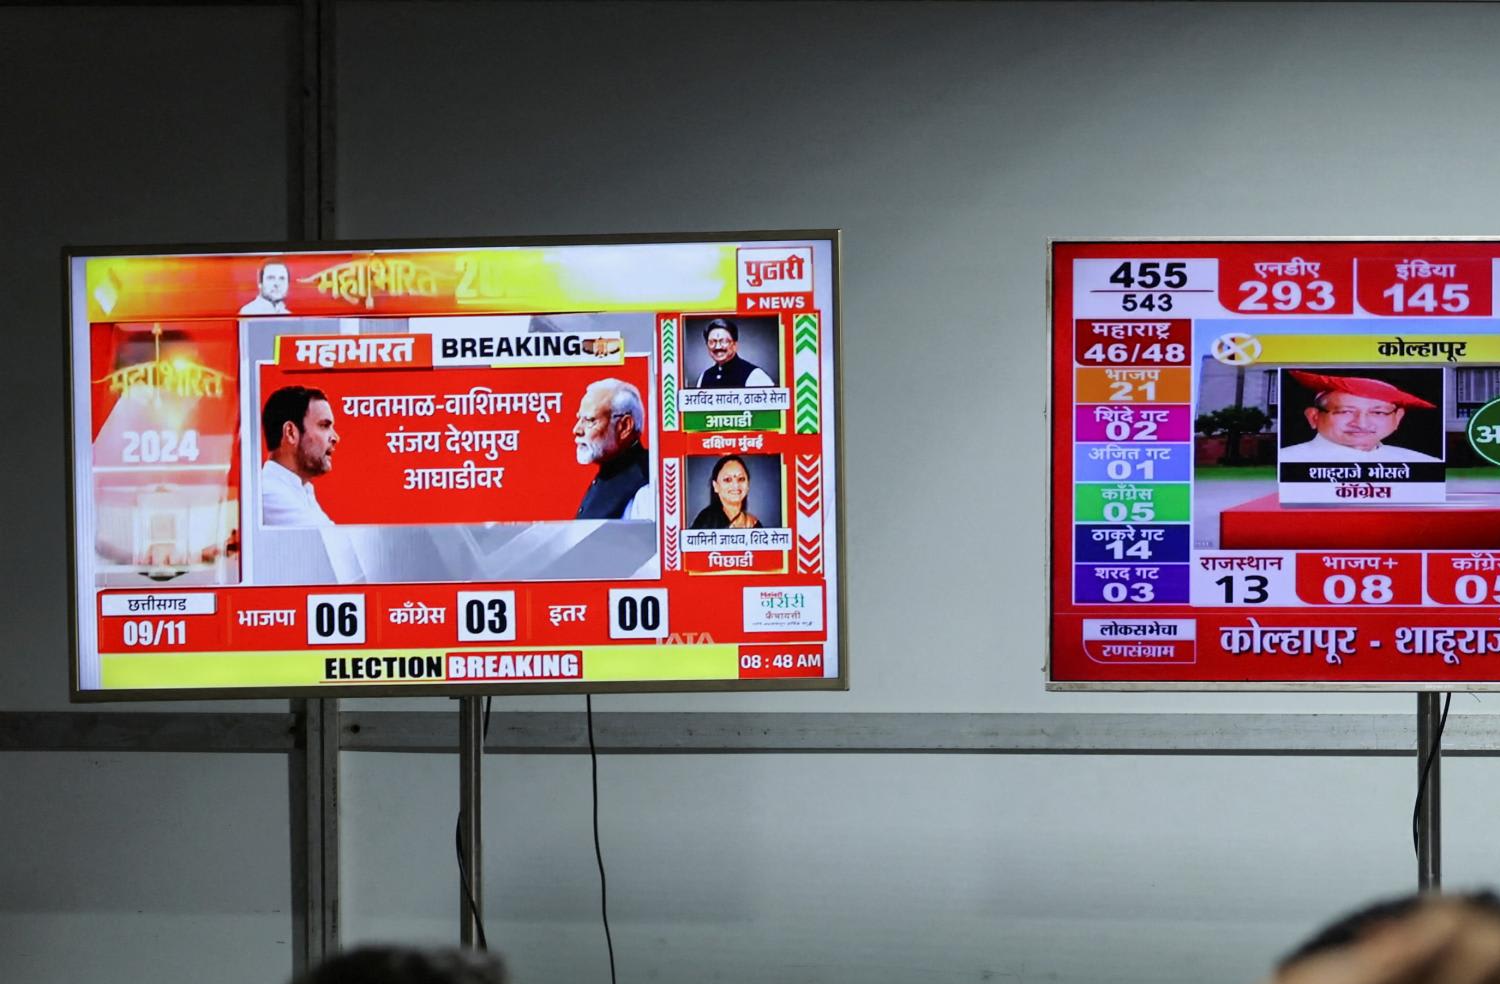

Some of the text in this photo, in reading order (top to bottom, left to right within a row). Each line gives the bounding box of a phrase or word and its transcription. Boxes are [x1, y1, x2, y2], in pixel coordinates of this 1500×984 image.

[745, 254, 804, 286] पुढारी
[1109, 262, 1187, 288] 455
[1254, 257, 1456, 280] एनडीए इंडिया
[760, 296, 805, 309] NEWS
[1122, 294, 1173, 312] 543
[1238, 280, 1470, 313] 293 145
[1091, 322, 1171, 339] महाराष्ट्र
[296, 335, 581, 367] महाभारत BREAKING
[1084, 343, 1185, 362] 46/48
[1377, 337, 1467, 362] कोल्हापूर
[1106, 369, 1160, 381] भाजप
[744, 391, 767, 404] ठाकरे
[769, 390, 787, 404] सेना
[1109, 382, 1156, 400] 21
[343, 387, 562, 422] यवतमाळ-वाशिममधून
[706, 411, 752, 428] आघाडी
[1093, 407, 1169, 422] शिंदे गट
[1105, 421, 1158, 440] 02
[121, 430, 199, 463] 2024
[386, 425, 519, 460] संजय देशमुख
[1088, 444, 1171, 460] अजित गट
[403, 461, 504, 489] आघाडीवर
[1107, 460, 1154, 479] 01
[1309, 463, 1410, 483] शाहूराजे भोसले
[1103, 502, 1155, 522] 05
[771, 532, 789, 544] सेना
[1091, 526, 1165, 541] ठाकरे गट
[708, 552, 753, 567] पिछाडी
[1105, 540, 1152, 560] 14
[1200, 556, 1283, 571] राजस्थान
[1094, 567, 1159, 580] शरद गट
[1103, 582, 1155, 602] 03
[1216, 575, 1269, 603] 13
[1323, 574, 1394, 605] 08
[237, 609, 295, 626] भाजपा
[315, 602, 358, 637] 06
[465, 599, 507, 634] 03
[549, 605, 587, 625] इतर
[618, 596, 660, 631] 00
[123, 621, 186, 646] 09/11
[1100, 621, 1178, 636] लोकसभेचा
[1102, 642, 1175, 658] रणसंग्राम
[1219, 617, 1357, 665] कोल्हापूर
[325, 655, 579, 679] ELECTION BREAKING
[740, 654, 821, 668] 08 48 AM
